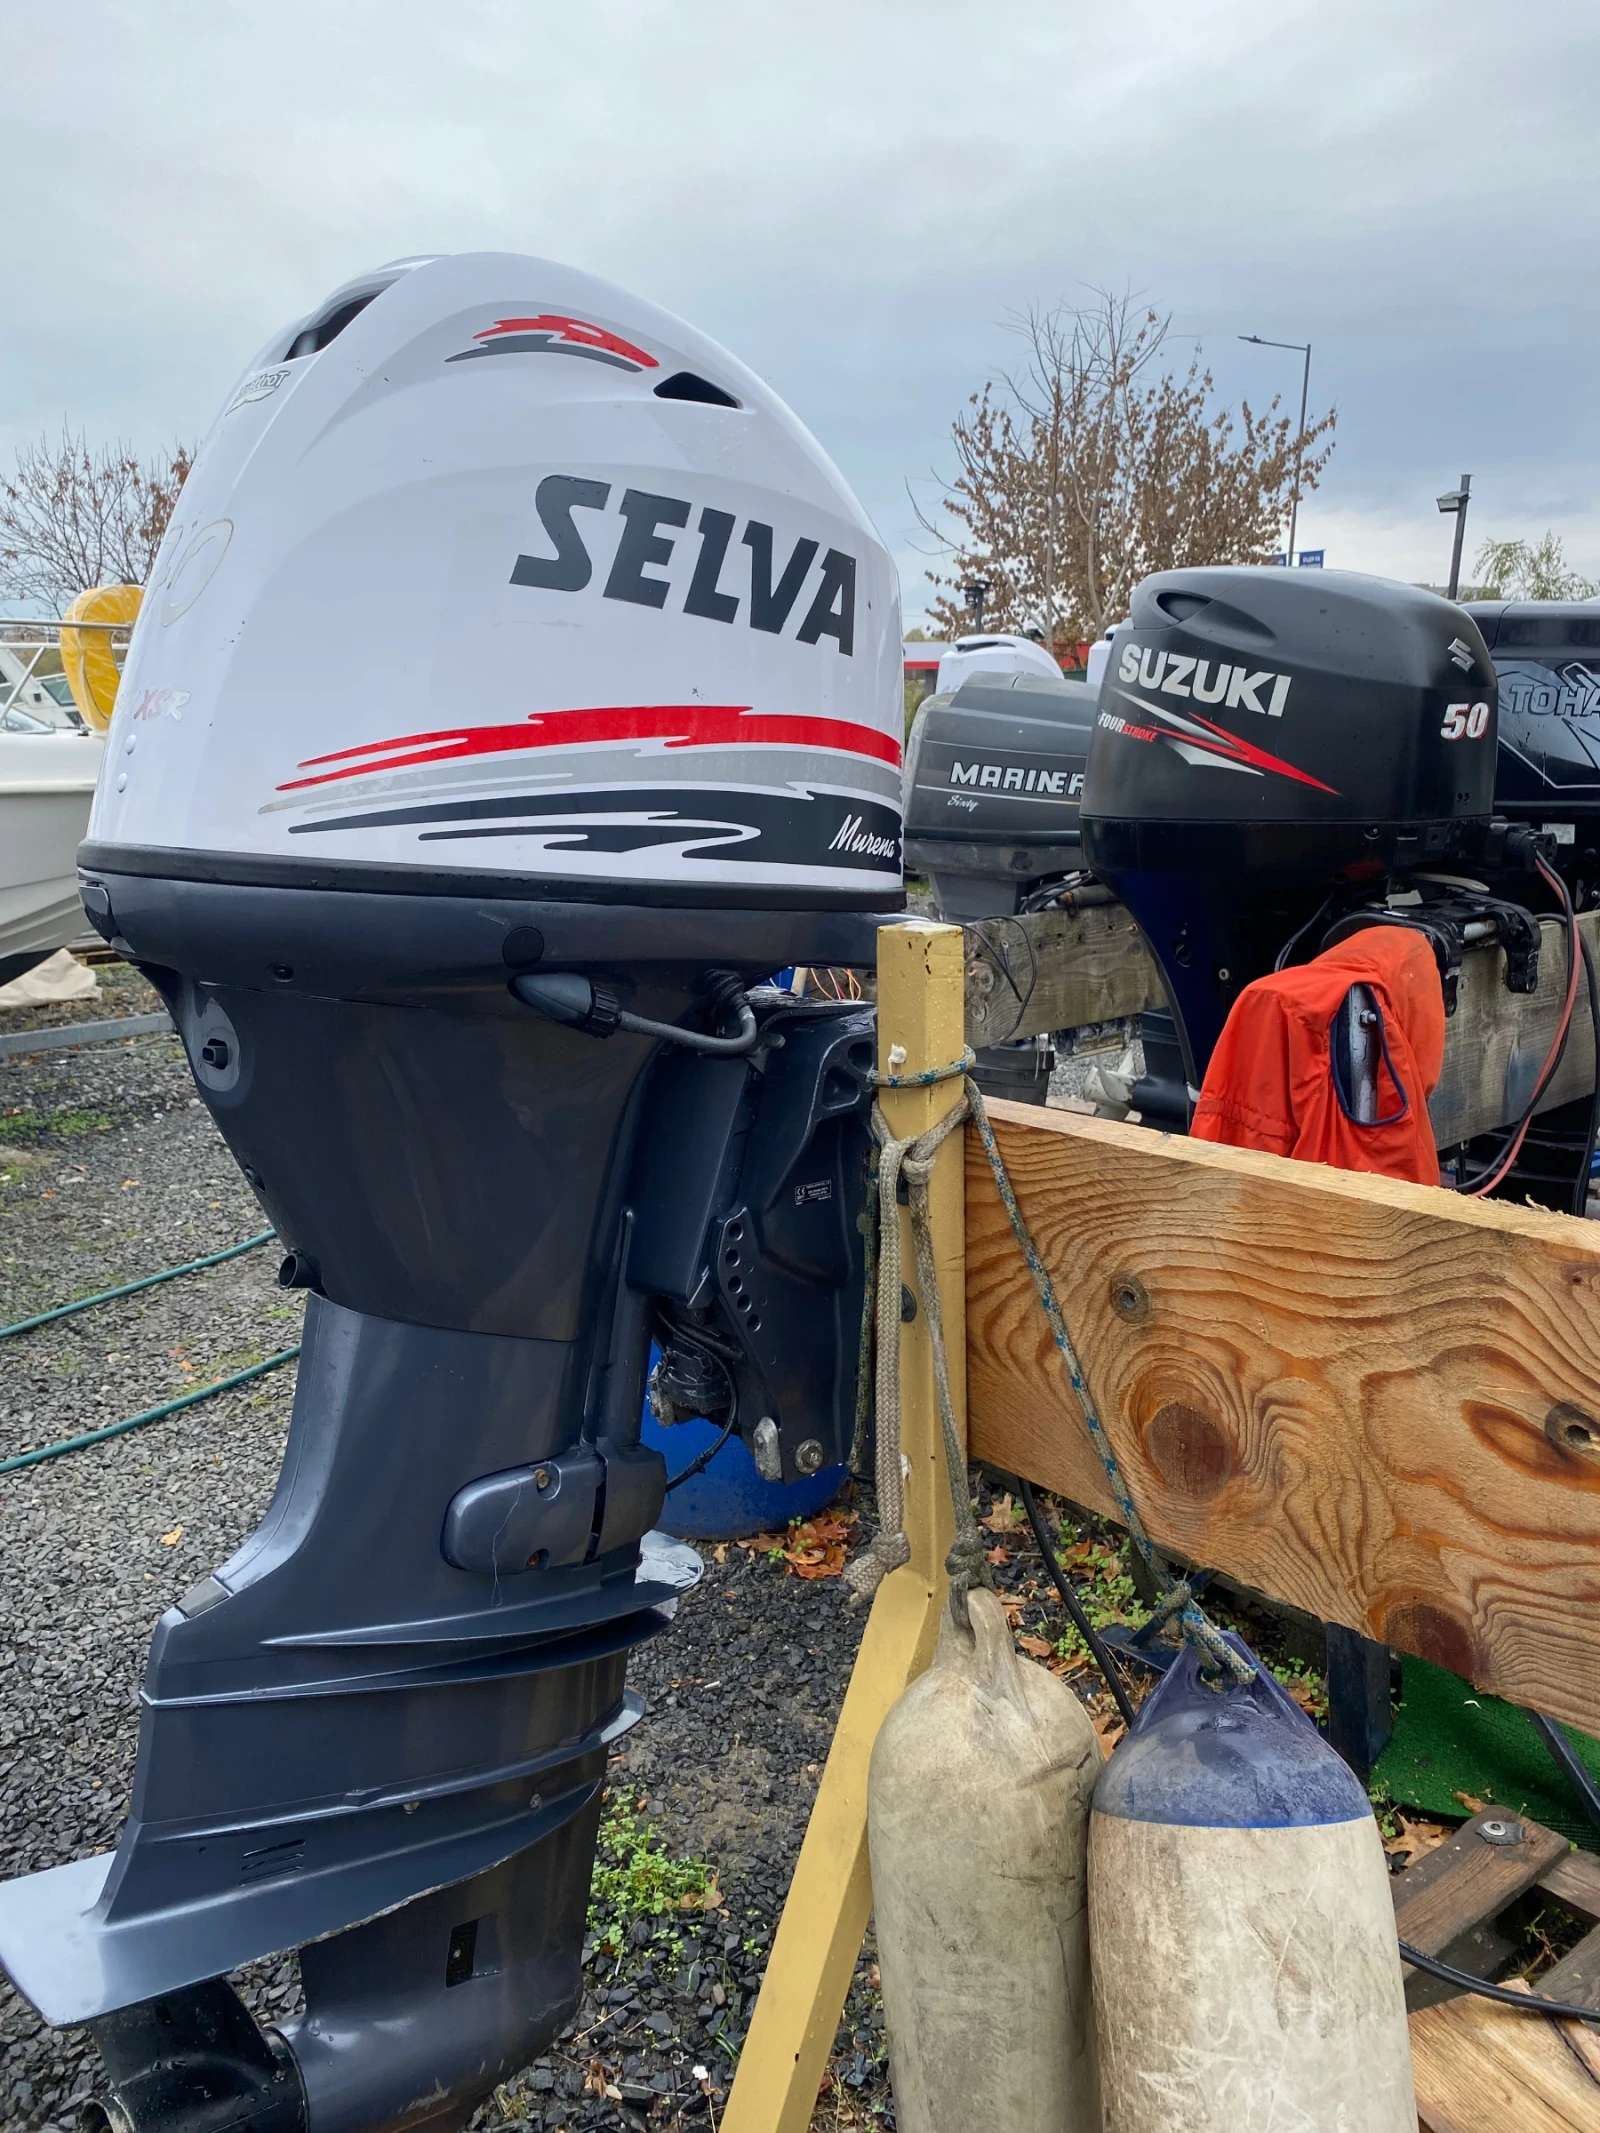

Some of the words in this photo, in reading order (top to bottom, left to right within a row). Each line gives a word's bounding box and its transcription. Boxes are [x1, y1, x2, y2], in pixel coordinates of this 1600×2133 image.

[509, 475, 856, 657] SELVA
[1118, 643, 1292, 717] SUZUKI
[1440, 702, 1490, 740] 50
[947, 794, 979, 812] Sixty
[828, 813, 895, 858] Murena
